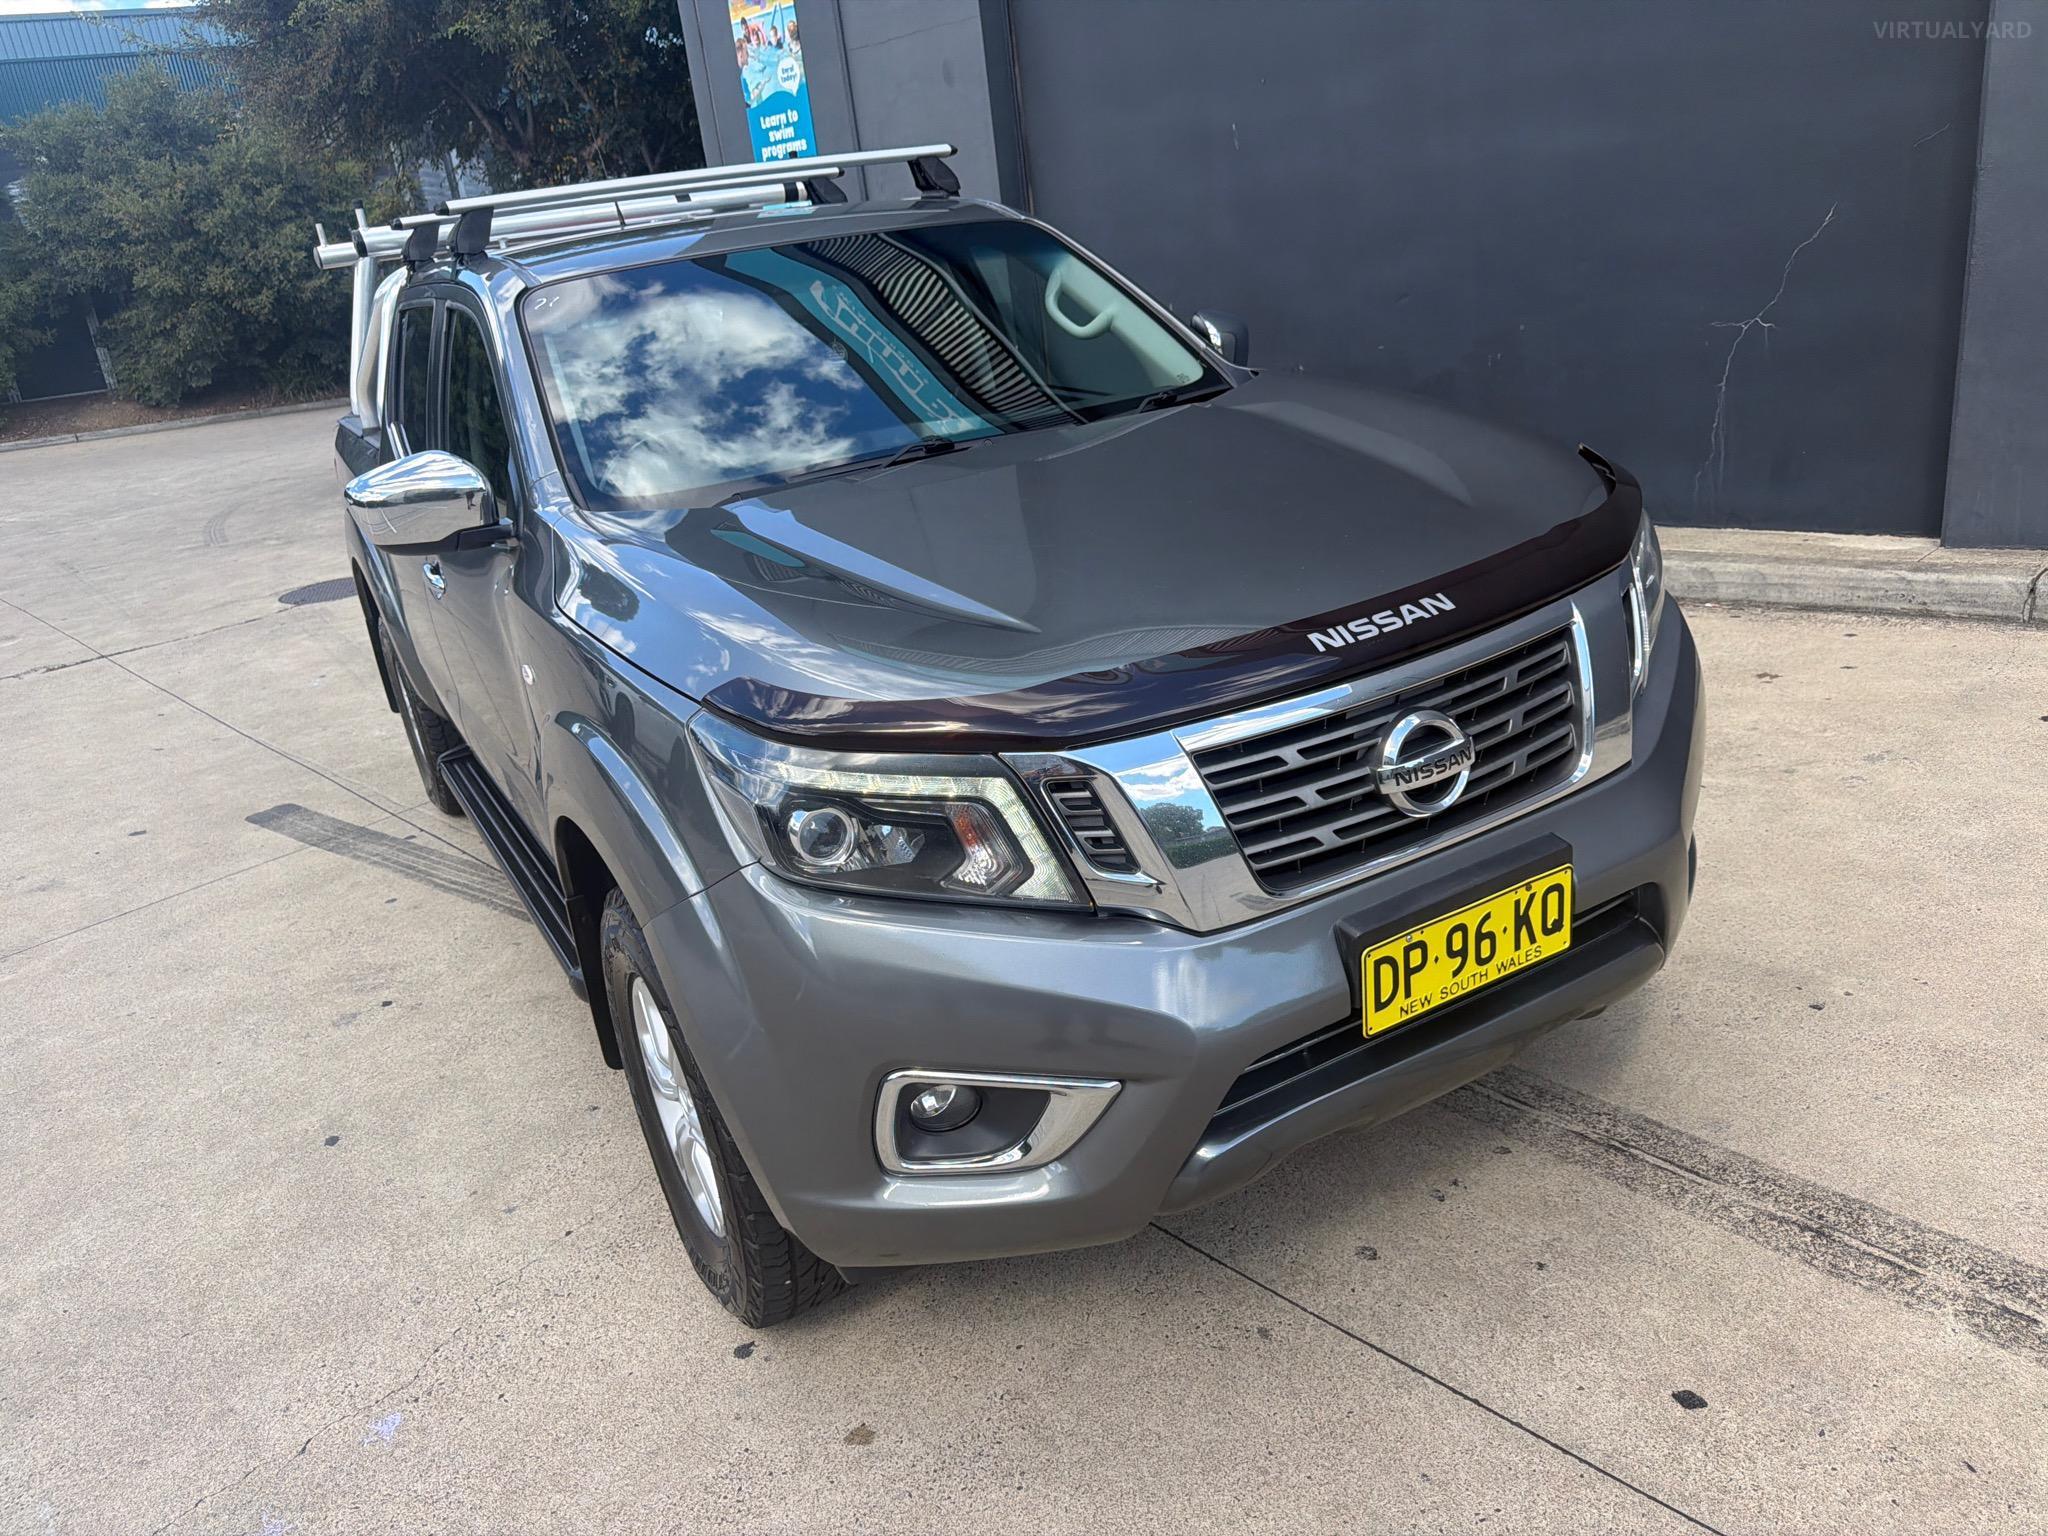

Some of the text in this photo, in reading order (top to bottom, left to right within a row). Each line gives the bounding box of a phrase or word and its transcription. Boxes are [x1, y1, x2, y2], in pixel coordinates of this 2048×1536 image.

[760, 109, 799, 130] Learn to
[769, 126, 795, 142] swim
[761, 138, 808, 162] programs
[1306, 592, 1457, 653] NISSAN
[1394, 746, 1472, 787] NISSAN
[1399, 945, 1542, 1019] NEW SOUTH WALES
